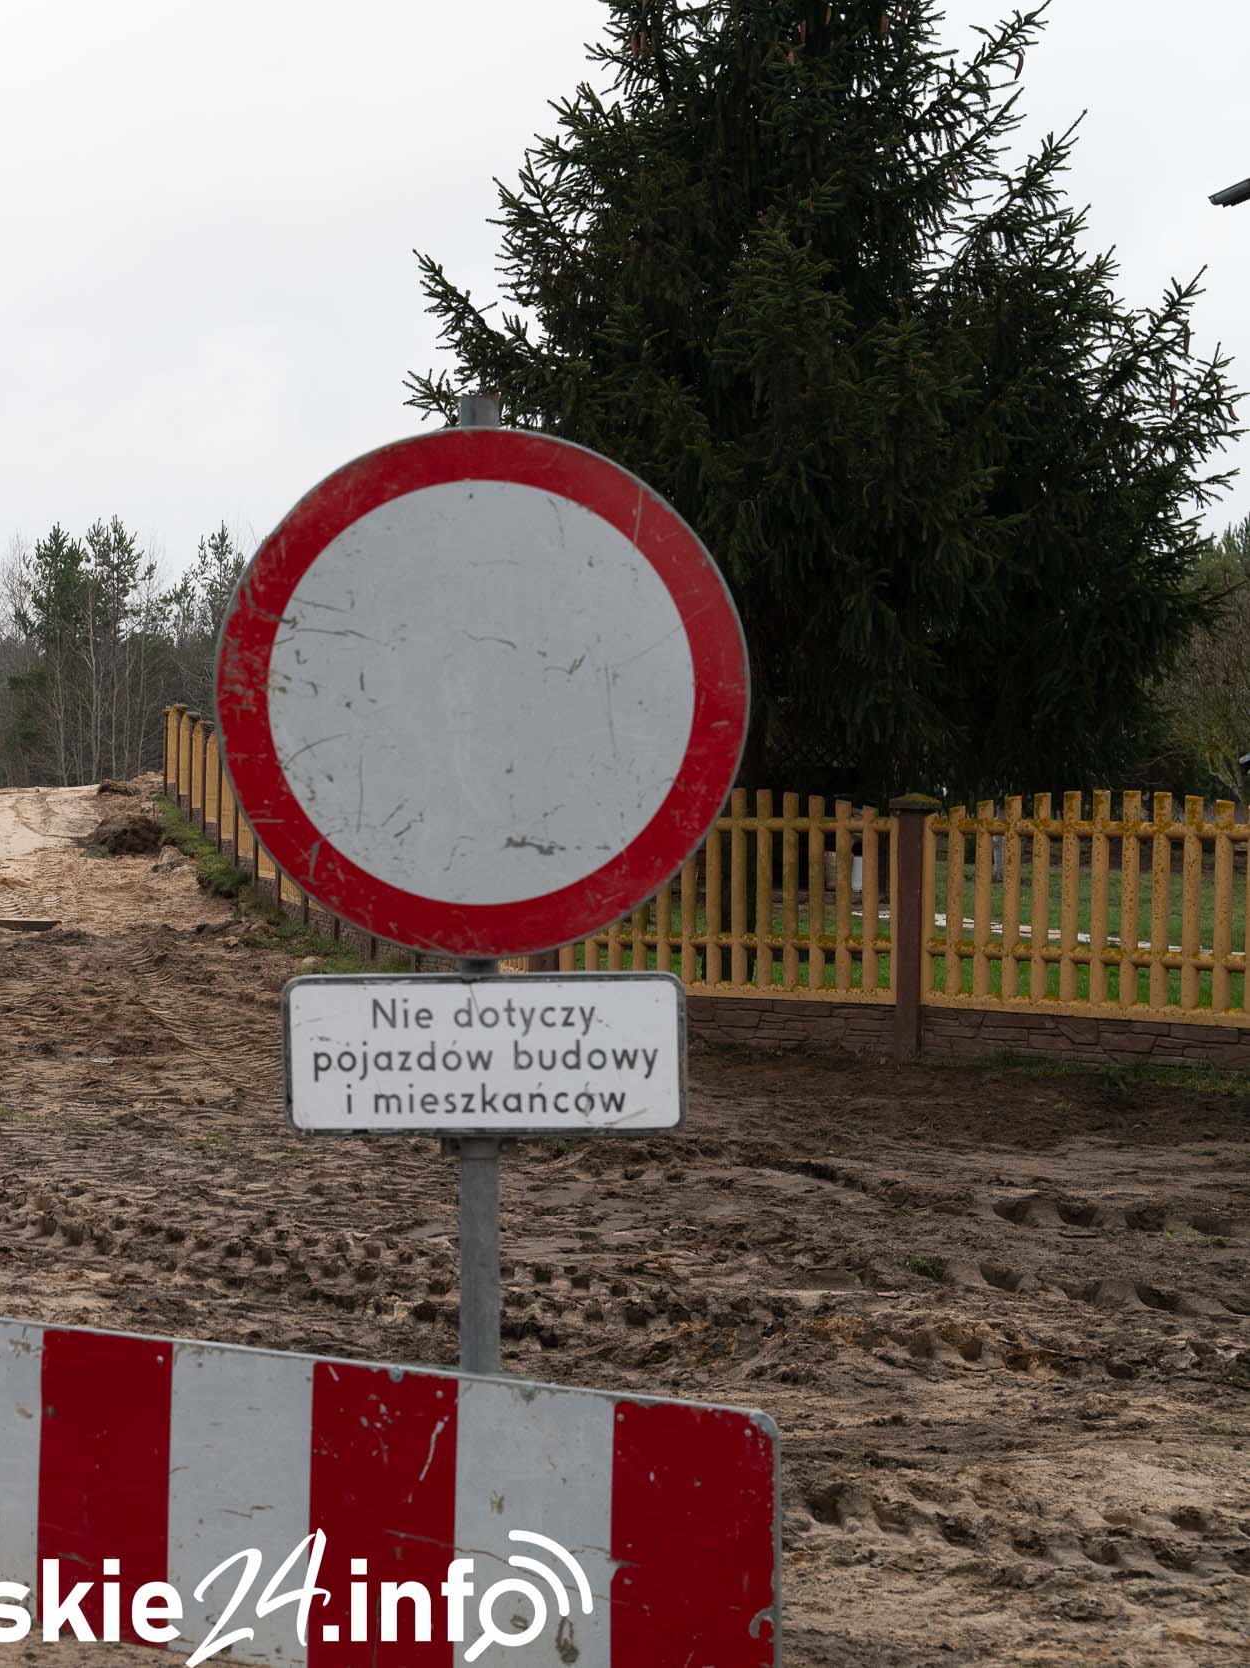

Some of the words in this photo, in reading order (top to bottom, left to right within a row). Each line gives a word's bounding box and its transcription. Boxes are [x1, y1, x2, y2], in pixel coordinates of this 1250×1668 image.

[371, 998, 434, 1029] Nie
[453, 998, 597, 1036] dotyczy
[312, 1040, 493, 1082] pojazdów
[513, 1040, 659, 1079] budowy
[345, 1084, 353, 1115] i
[373, 1083, 627, 1116] mieszkańców
